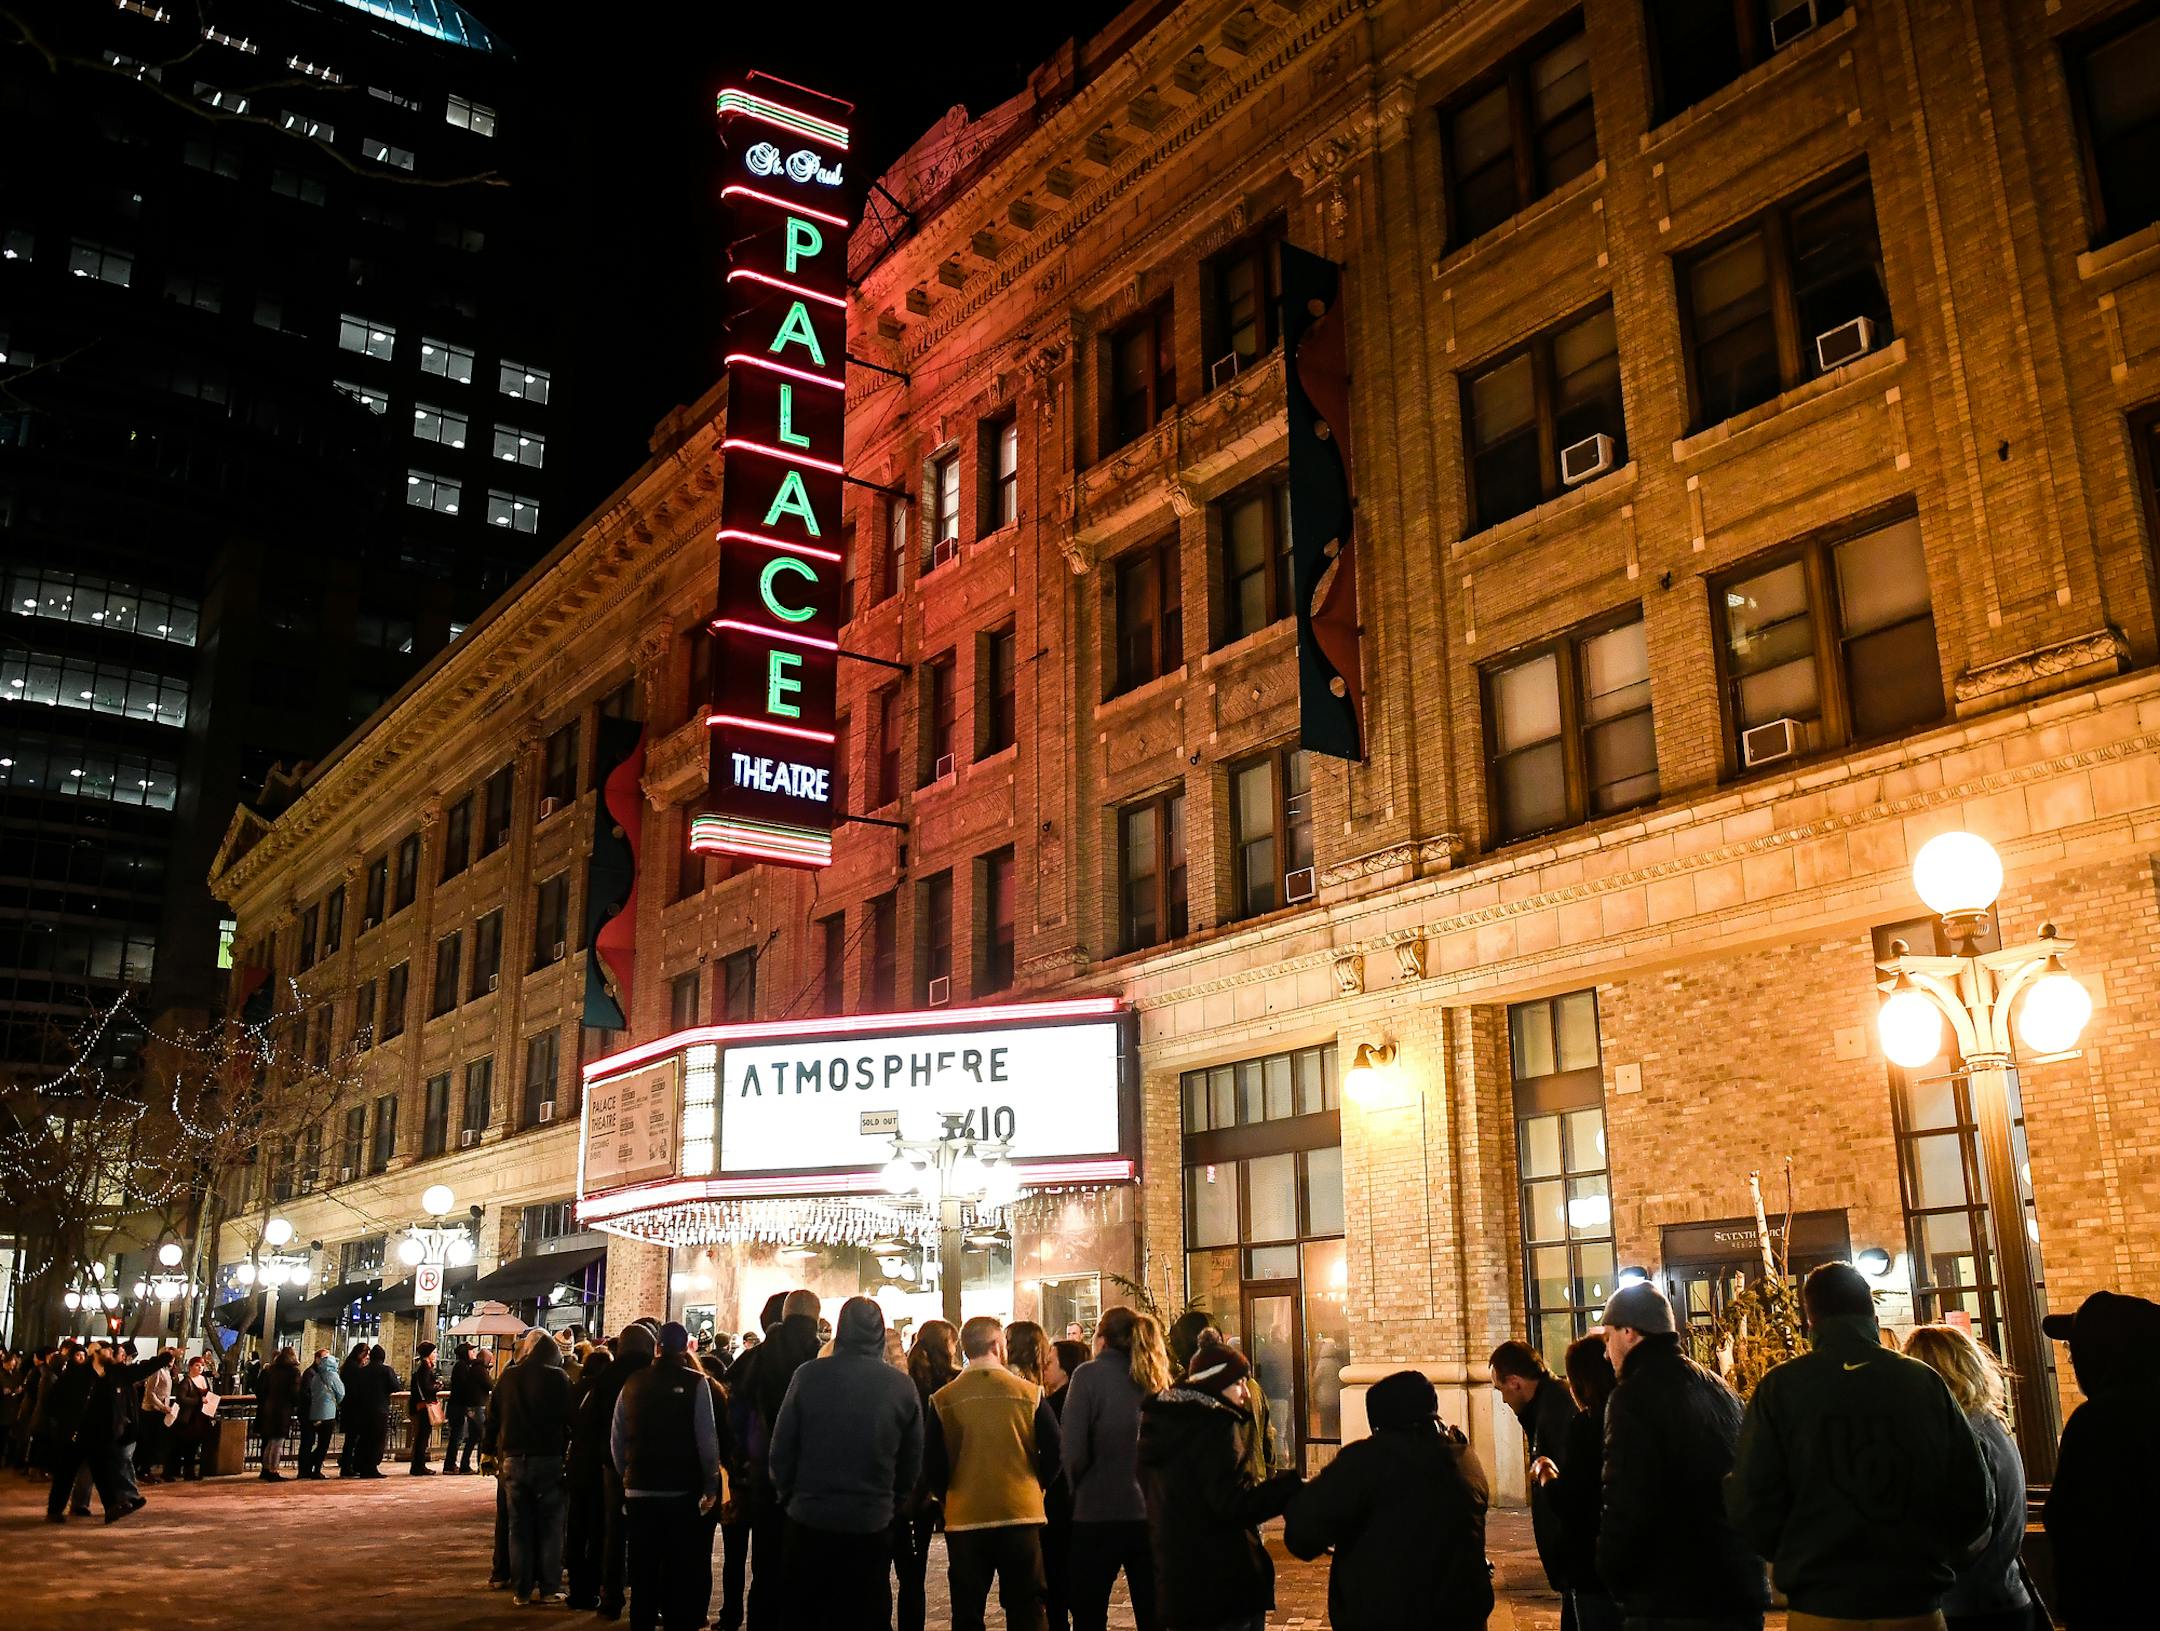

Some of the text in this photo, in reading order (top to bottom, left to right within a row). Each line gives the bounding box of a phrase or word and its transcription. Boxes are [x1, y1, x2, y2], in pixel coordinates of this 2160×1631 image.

[745, 141, 844, 186] St. Paul
[759, 216, 826, 719] PALACE
[731, 751, 830, 803] THEATRE
[592, 1096, 616, 1114] PALACE
[862, 1117, 898, 1127] SOLD OUT
